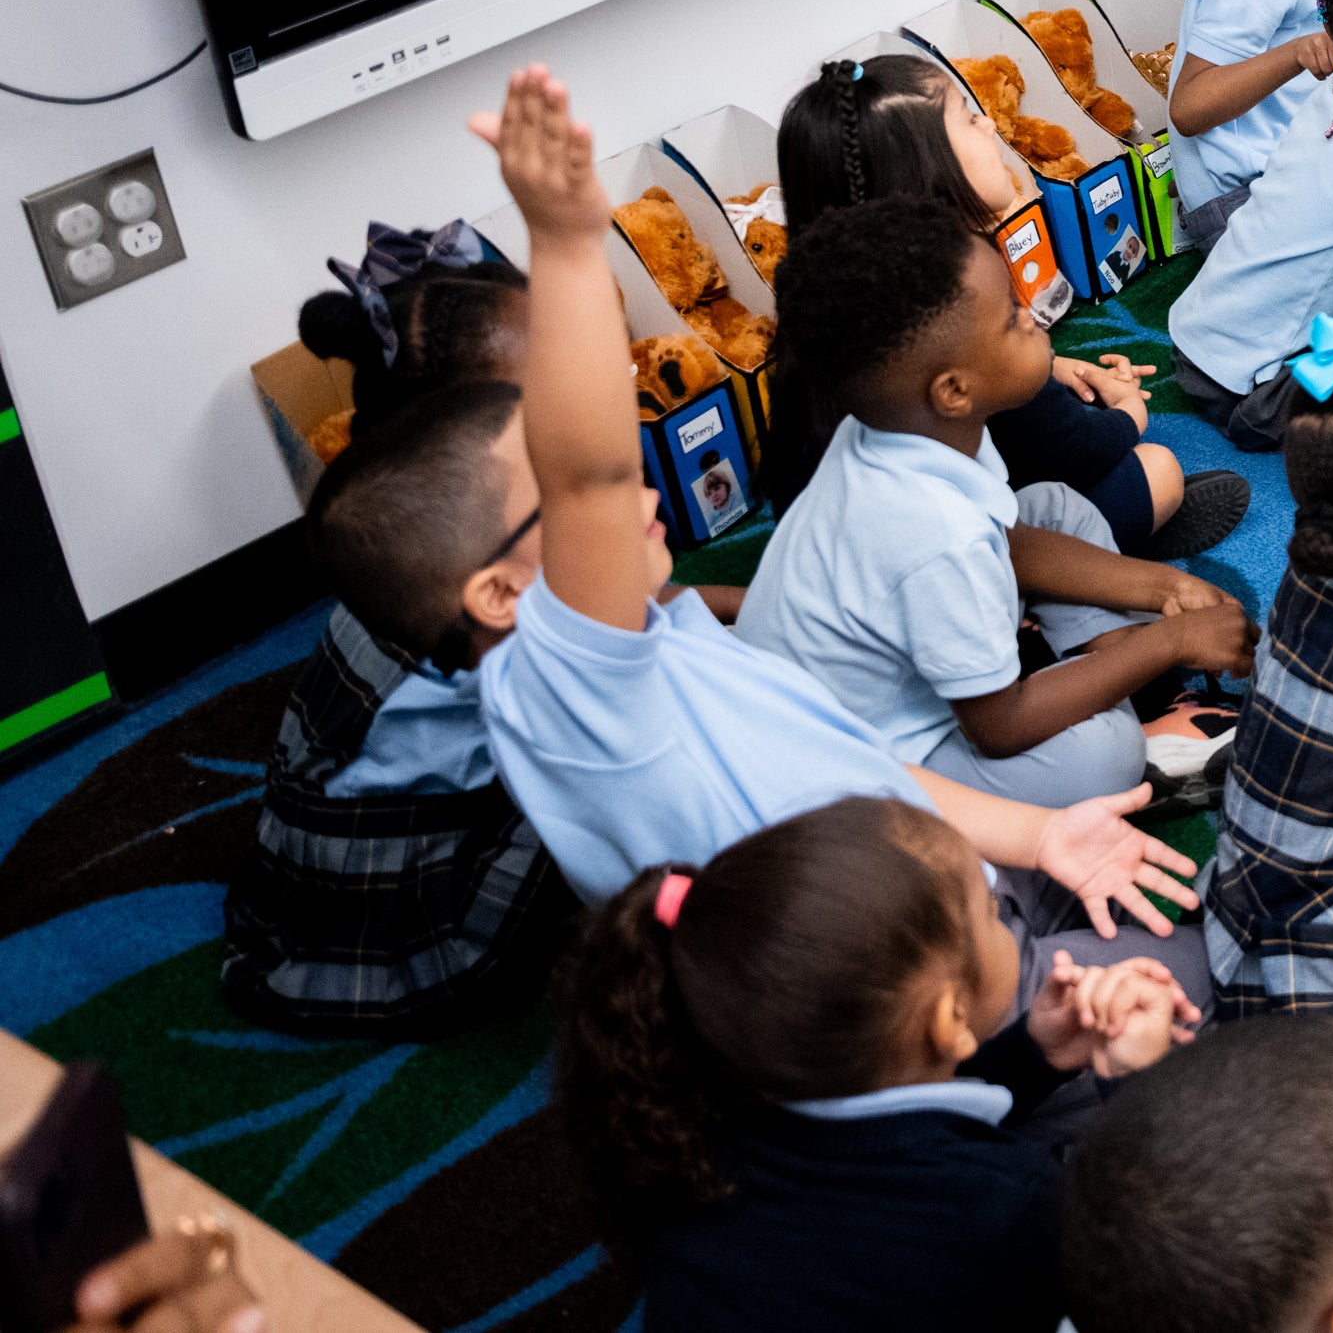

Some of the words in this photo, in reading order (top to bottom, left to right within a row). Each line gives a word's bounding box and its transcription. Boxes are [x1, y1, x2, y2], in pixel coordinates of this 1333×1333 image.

[1008, 233, 1033, 257] Bluey
[1104, 269, 1115, 285] Noa
[681, 422, 716, 447] Tommy
